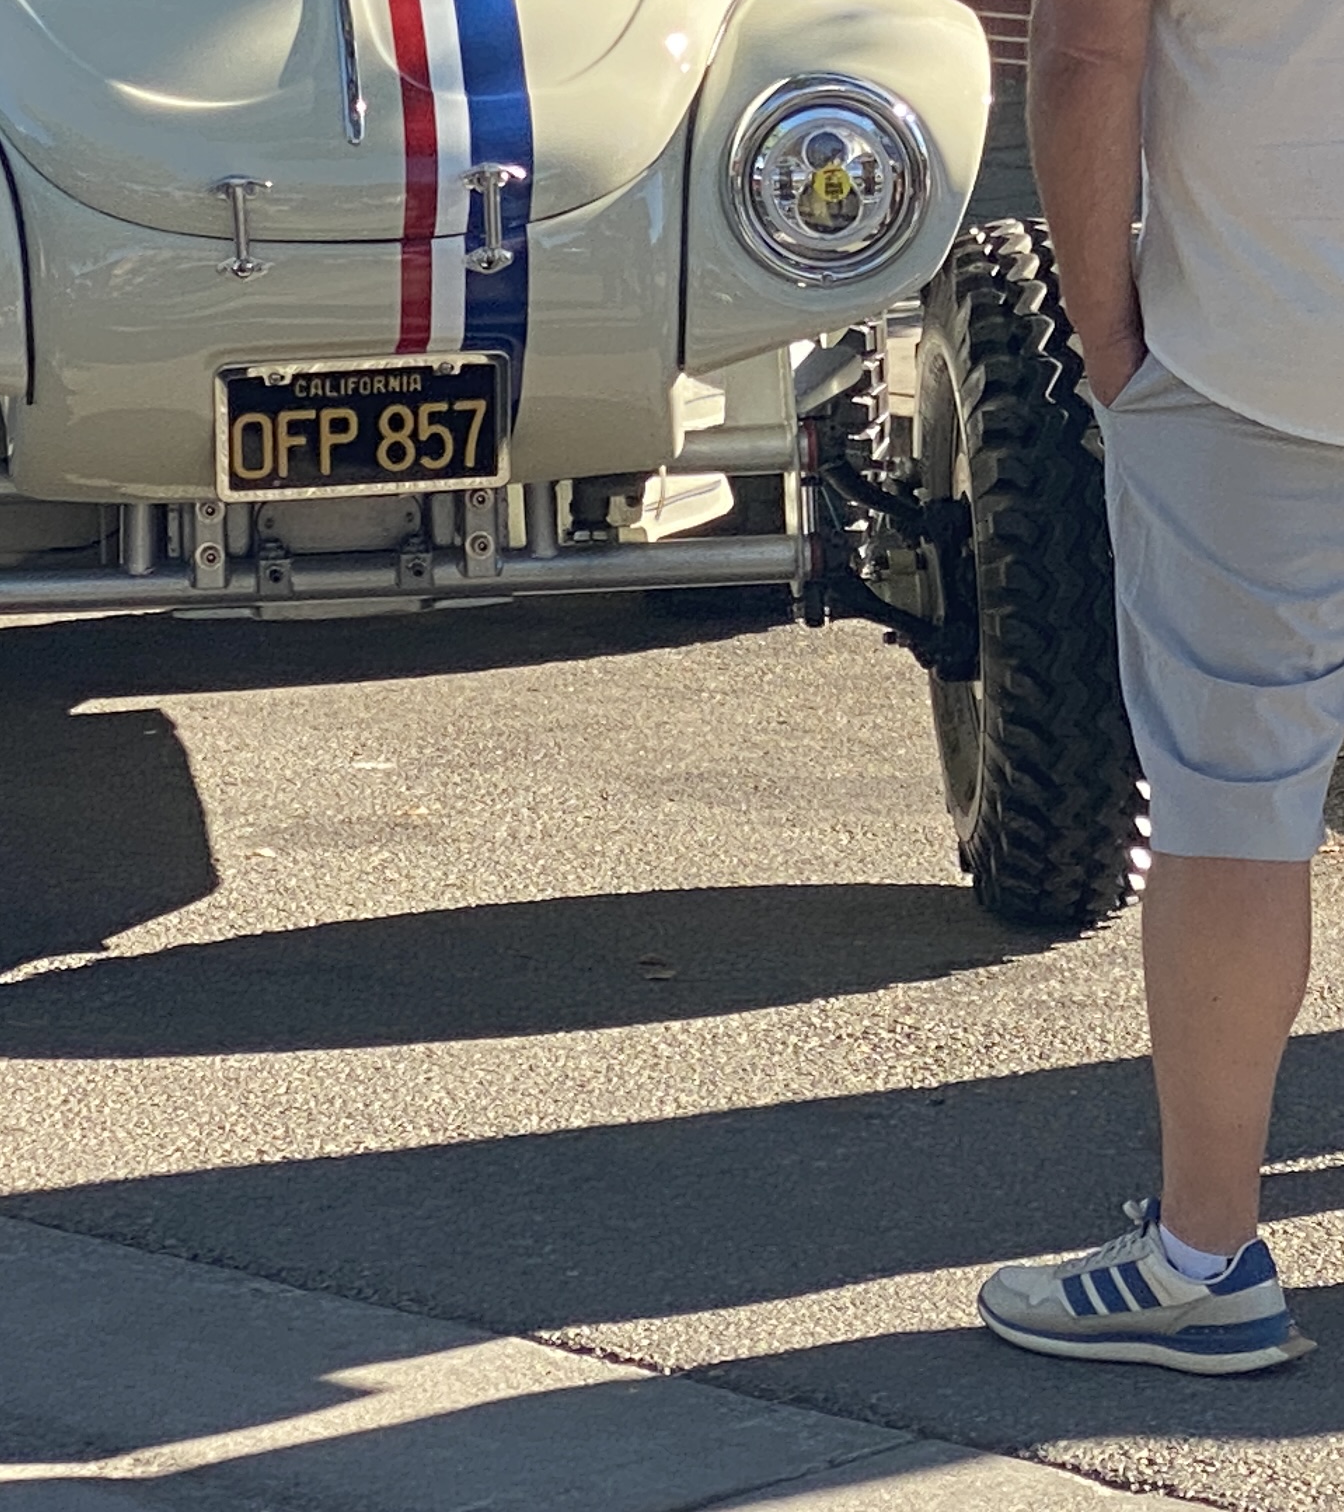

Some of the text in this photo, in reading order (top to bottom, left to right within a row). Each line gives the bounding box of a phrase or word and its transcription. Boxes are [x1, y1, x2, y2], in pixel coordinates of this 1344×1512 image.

[294, 373, 423, 398] CALIFORNIA
[232, 399, 487, 479] OFP 857
